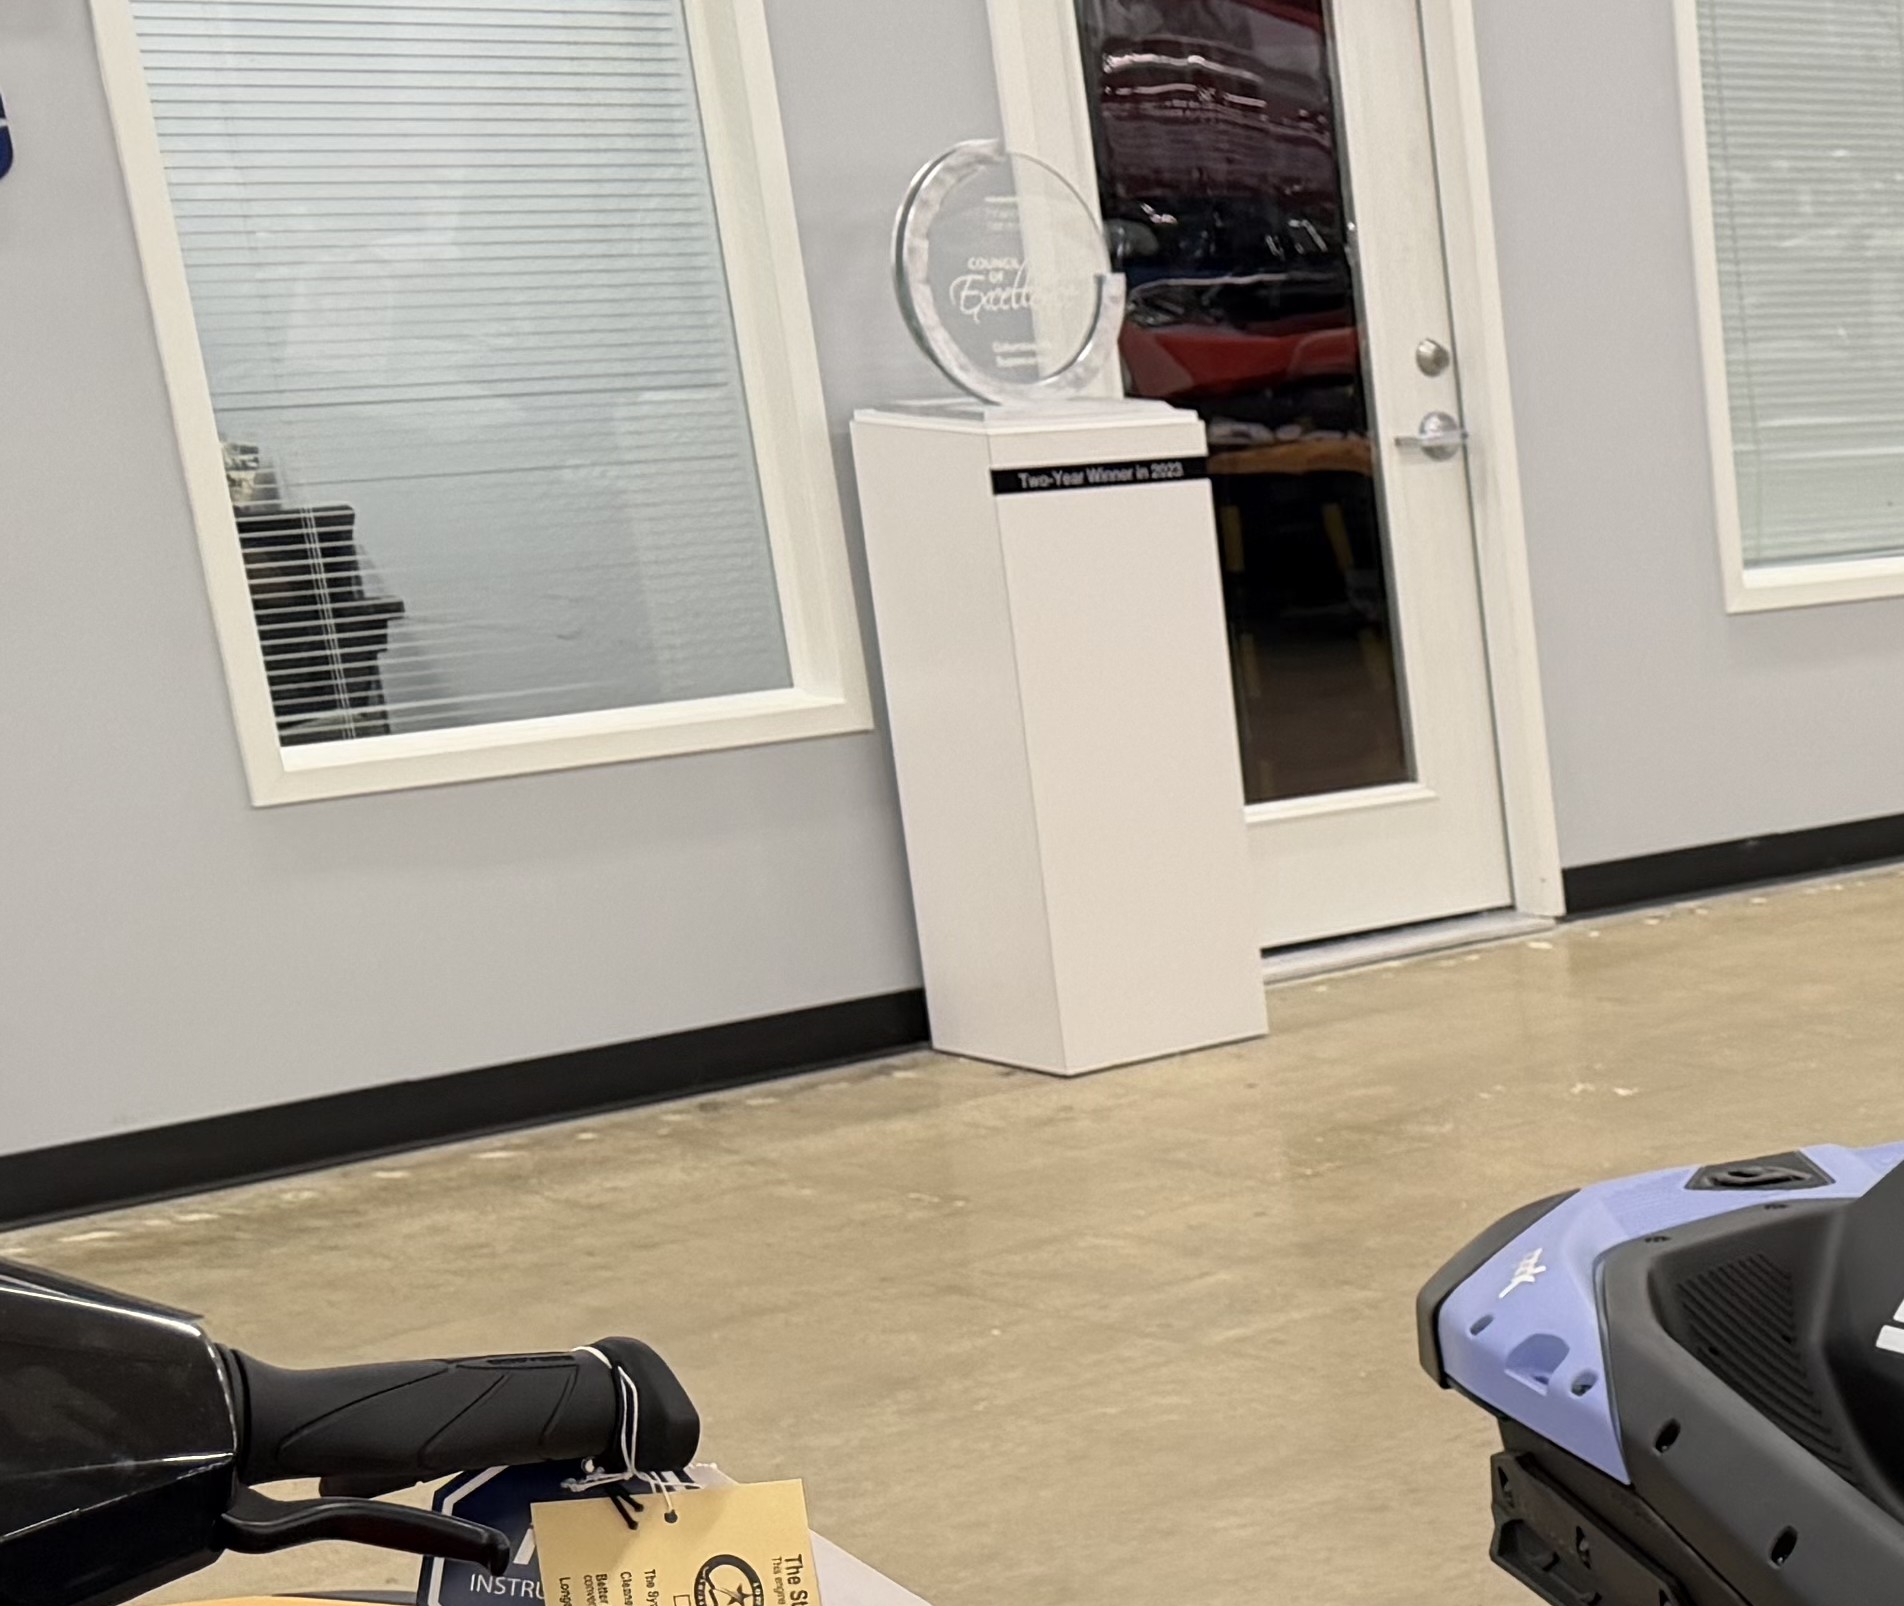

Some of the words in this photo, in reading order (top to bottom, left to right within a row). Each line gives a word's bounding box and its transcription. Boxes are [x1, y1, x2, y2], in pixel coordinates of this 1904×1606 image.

[1016, 469, 1085, 489] Two-Year
[1086, 466, 1134, 484] Winner
[1136, 464, 1150, 479] in
[643, 1568, 656, 1588] The
[784, 1553, 803, 1585] The
